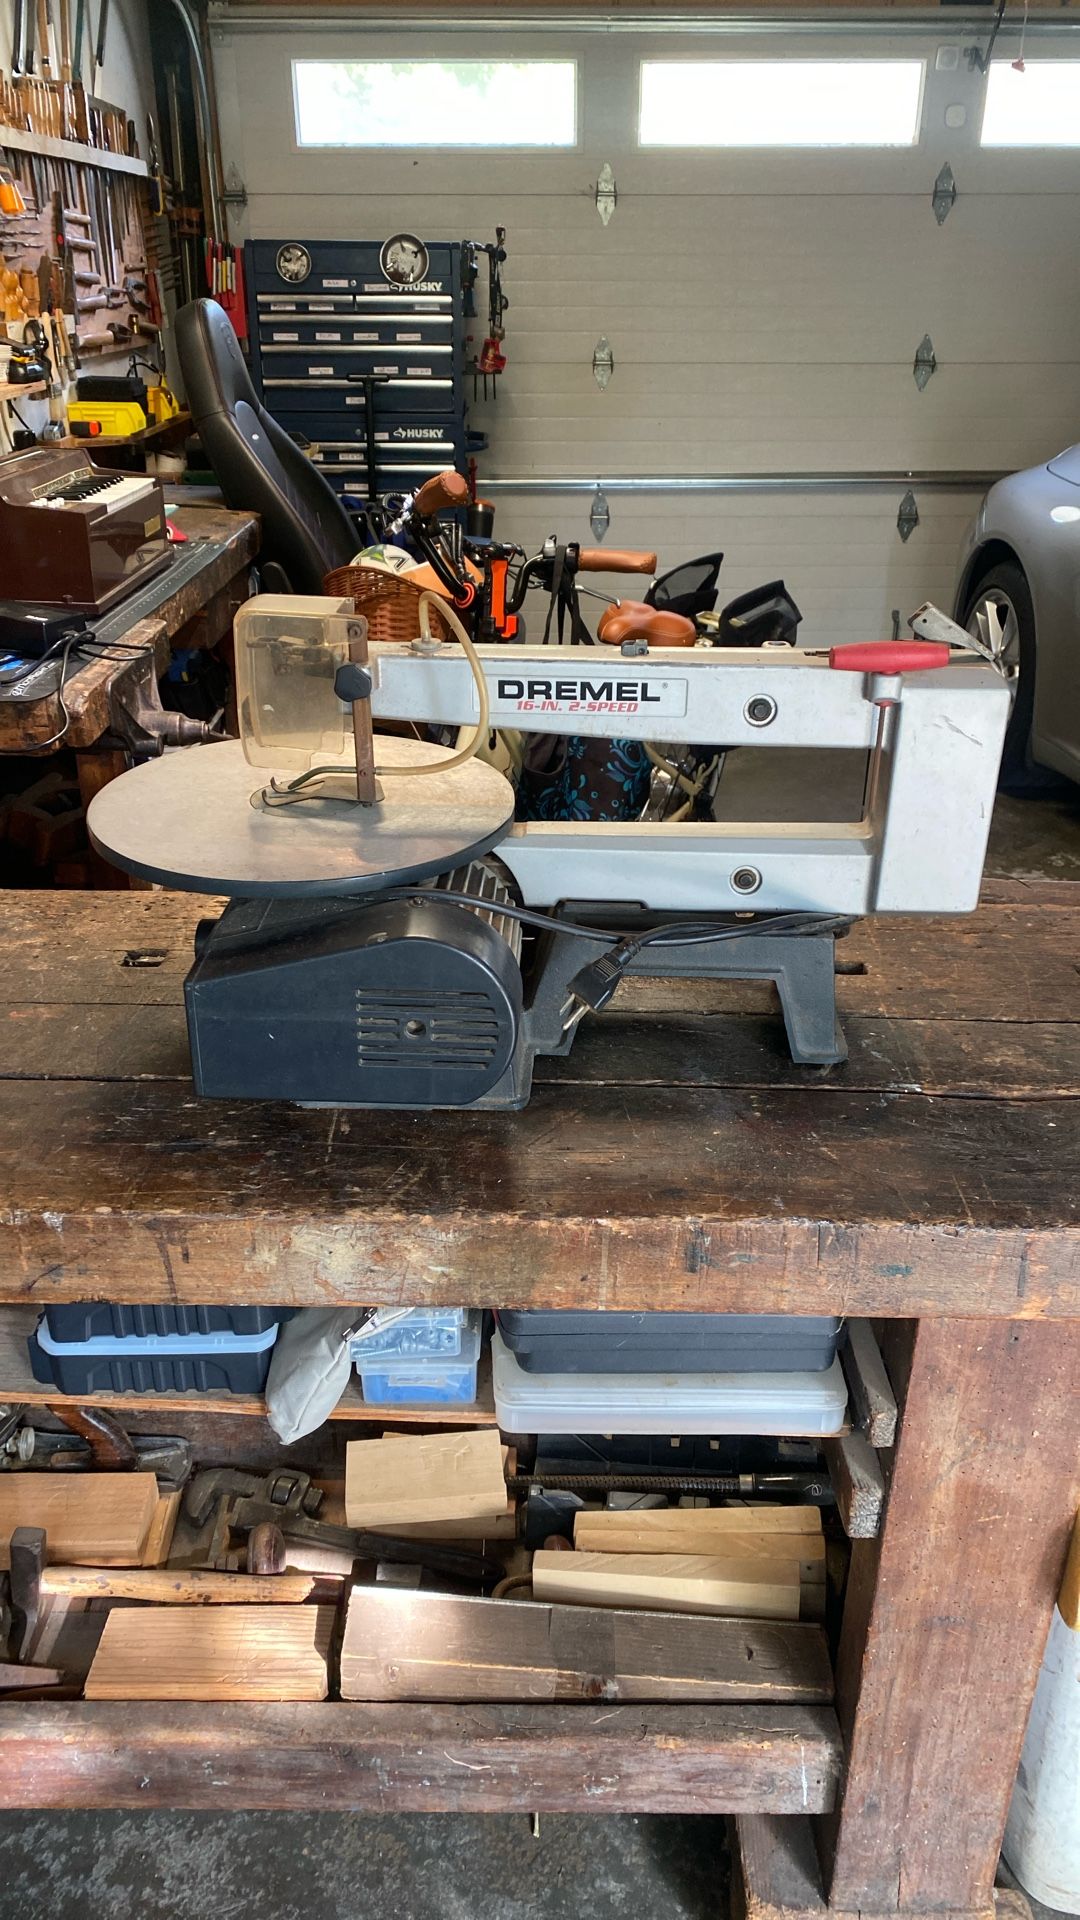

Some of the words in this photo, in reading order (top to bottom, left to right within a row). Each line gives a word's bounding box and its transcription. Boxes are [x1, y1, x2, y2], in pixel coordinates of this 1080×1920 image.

[407, 428, 443, 438] HUSKY
[498, 679, 661, 702] DREMEL
[517, 700, 562, 711] 16-IN.
[569, 701, 638, 713] 2-SPEED
